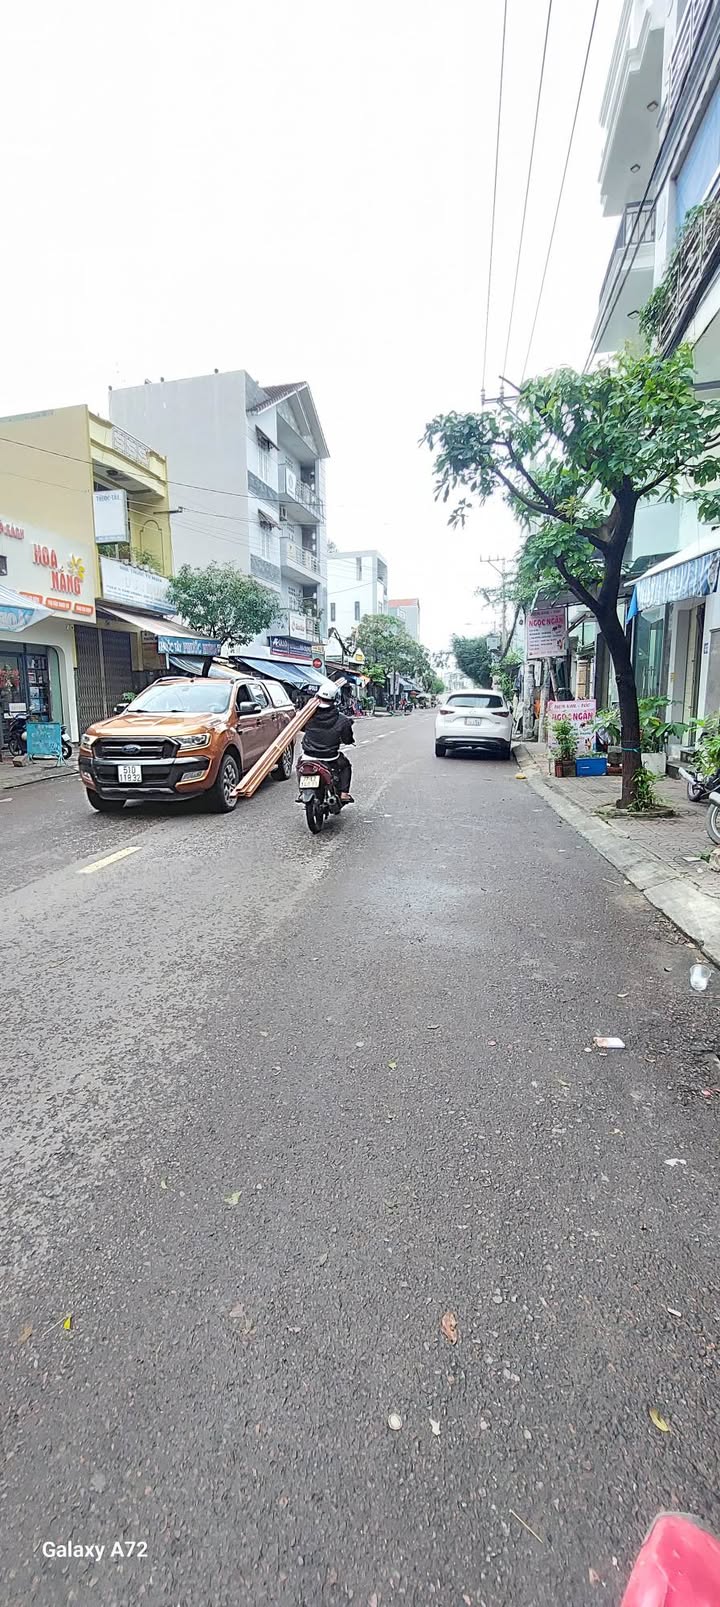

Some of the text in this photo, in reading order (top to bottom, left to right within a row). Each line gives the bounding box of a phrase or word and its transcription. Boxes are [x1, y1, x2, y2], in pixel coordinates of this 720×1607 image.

[33, 543, 58, 569] HOA
[50, 565, 82, 596] NẮNG
[572, 710, 593, 721] NGÂN
